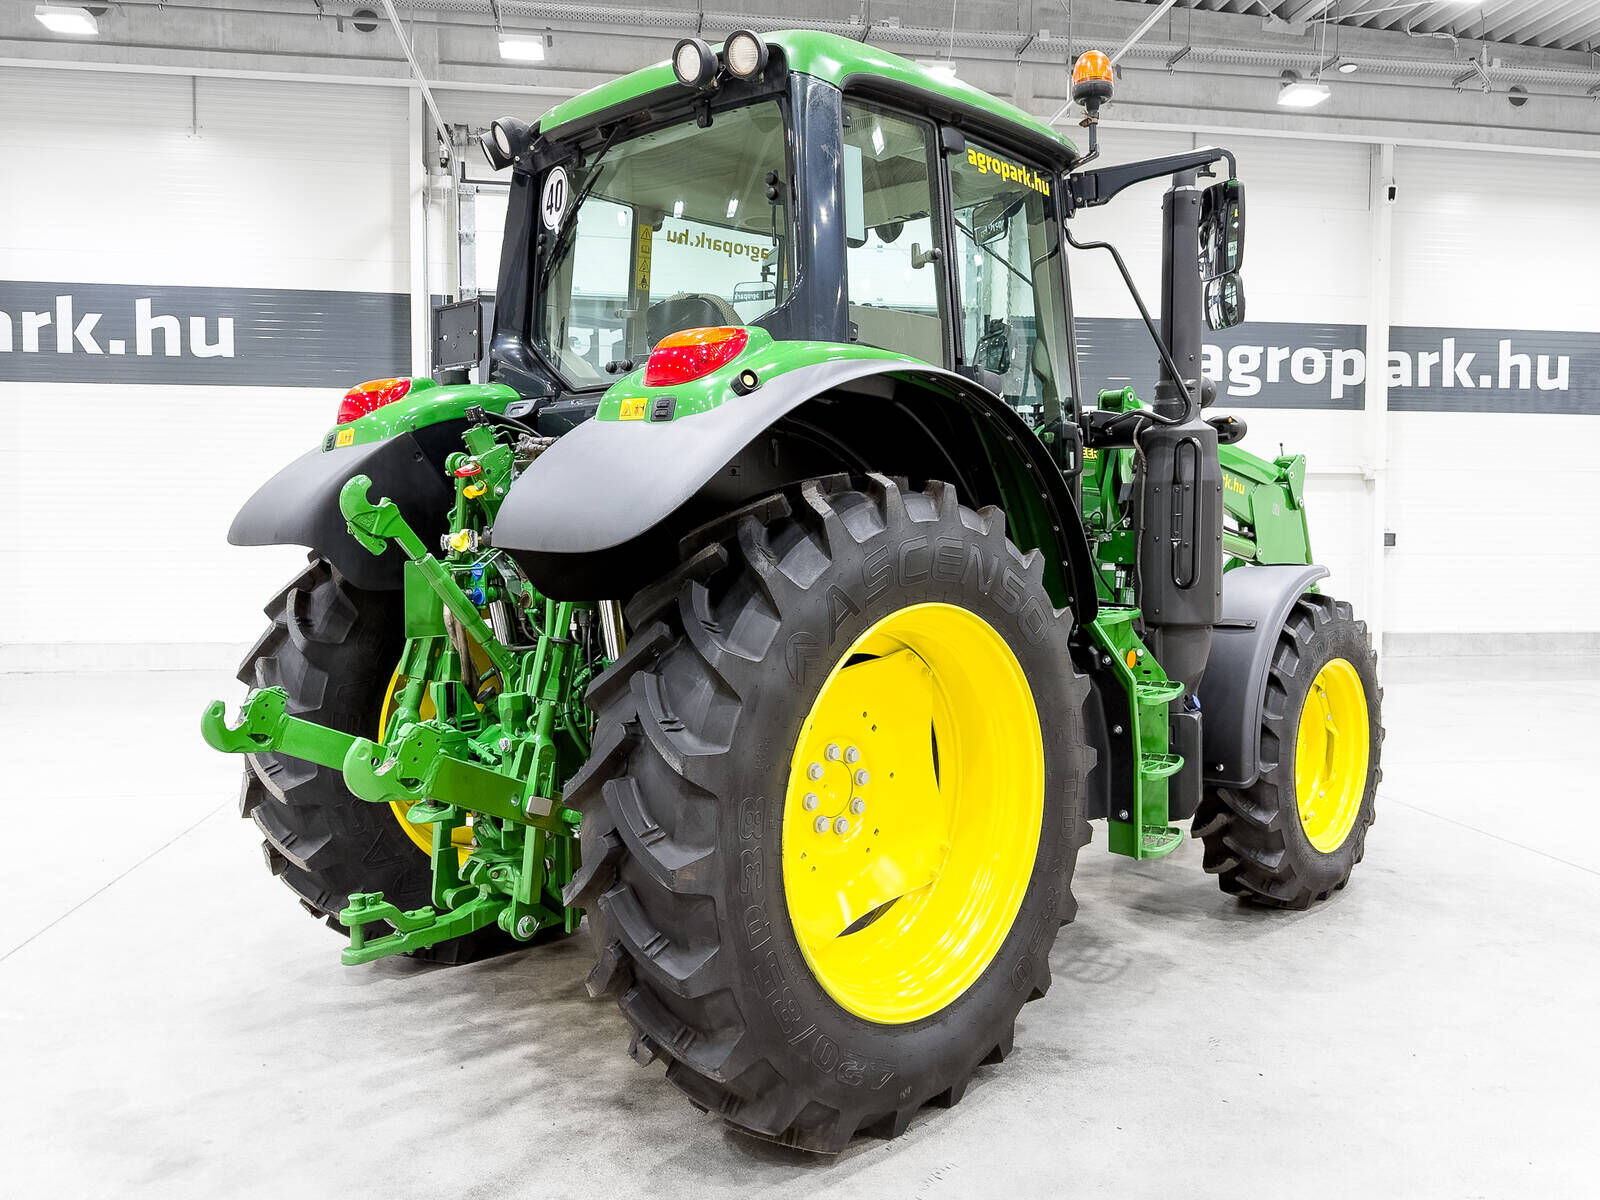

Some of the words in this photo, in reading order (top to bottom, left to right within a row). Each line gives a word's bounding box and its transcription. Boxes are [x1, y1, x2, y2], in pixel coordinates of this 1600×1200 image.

[546, 179, 564, 215] 40
[967, 148, 1050, 197] agropark.hu
[0, 294, 235, 358] rk.hu
[1201, 337, 1570, 400] agropark.hu
[826, 535, 1049, 648] ASCENSO
